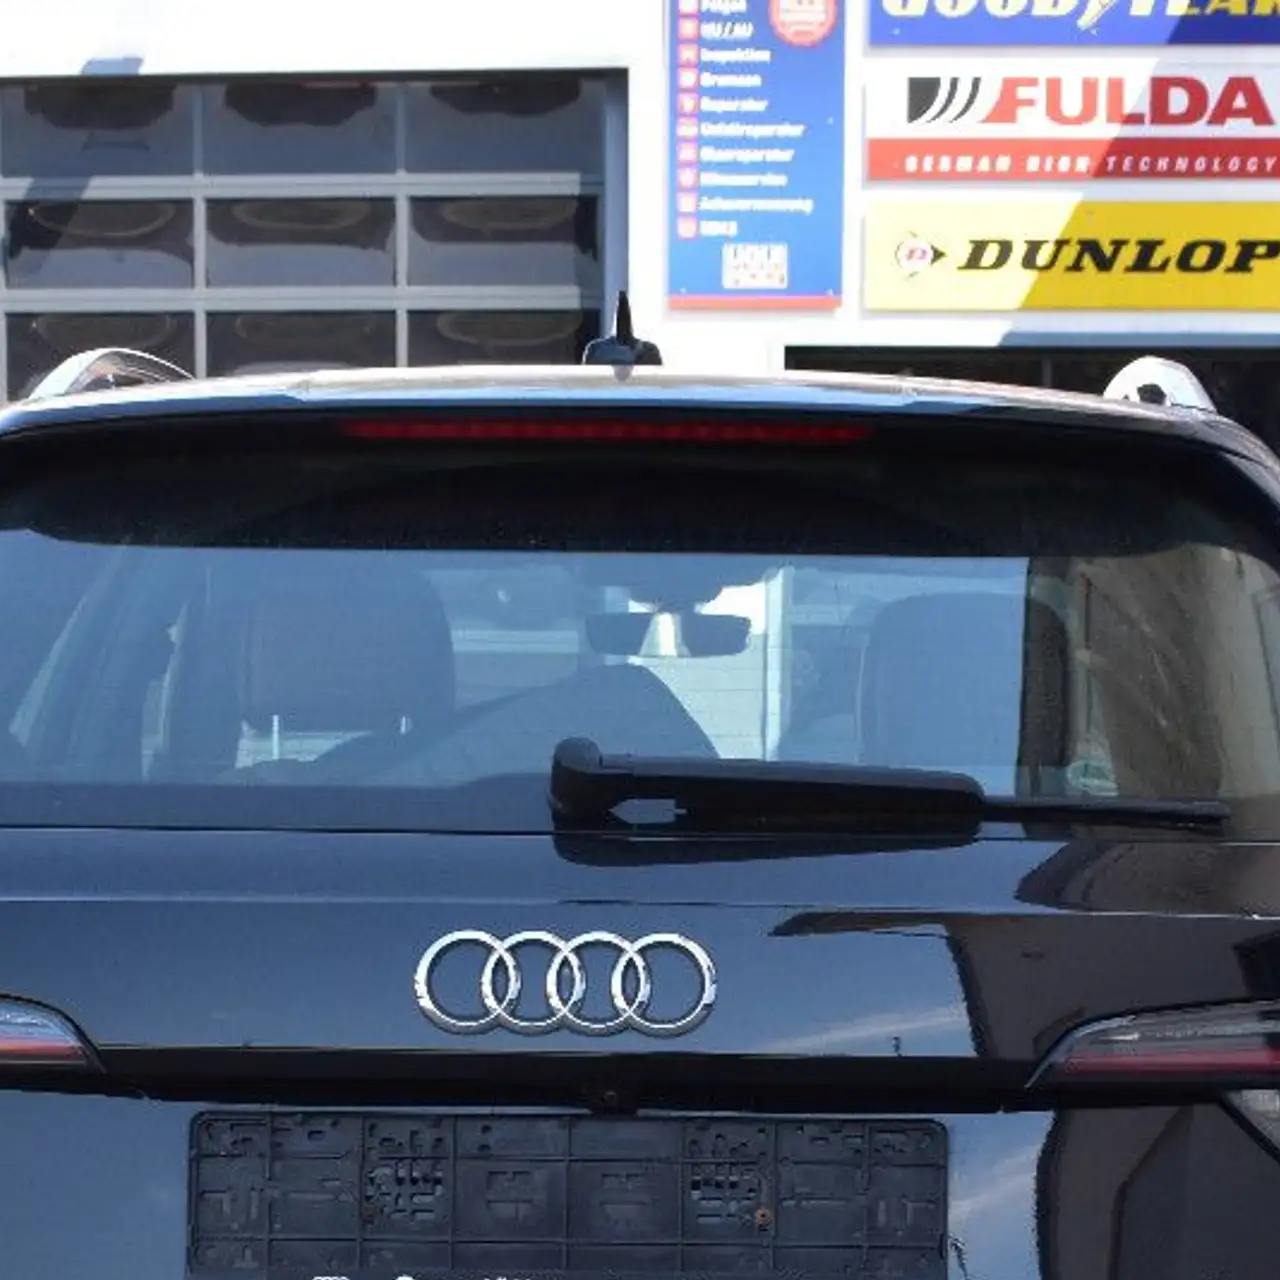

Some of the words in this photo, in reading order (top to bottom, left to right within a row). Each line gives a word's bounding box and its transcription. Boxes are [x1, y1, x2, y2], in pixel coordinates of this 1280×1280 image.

[979, 76, 1275, 126] FULDA
[904, 155, 1011, 173] GERMAN
[1026, 155, 1090, 173] HIGH
[1105, 156, 1279, 172] TECHNOLOGY
